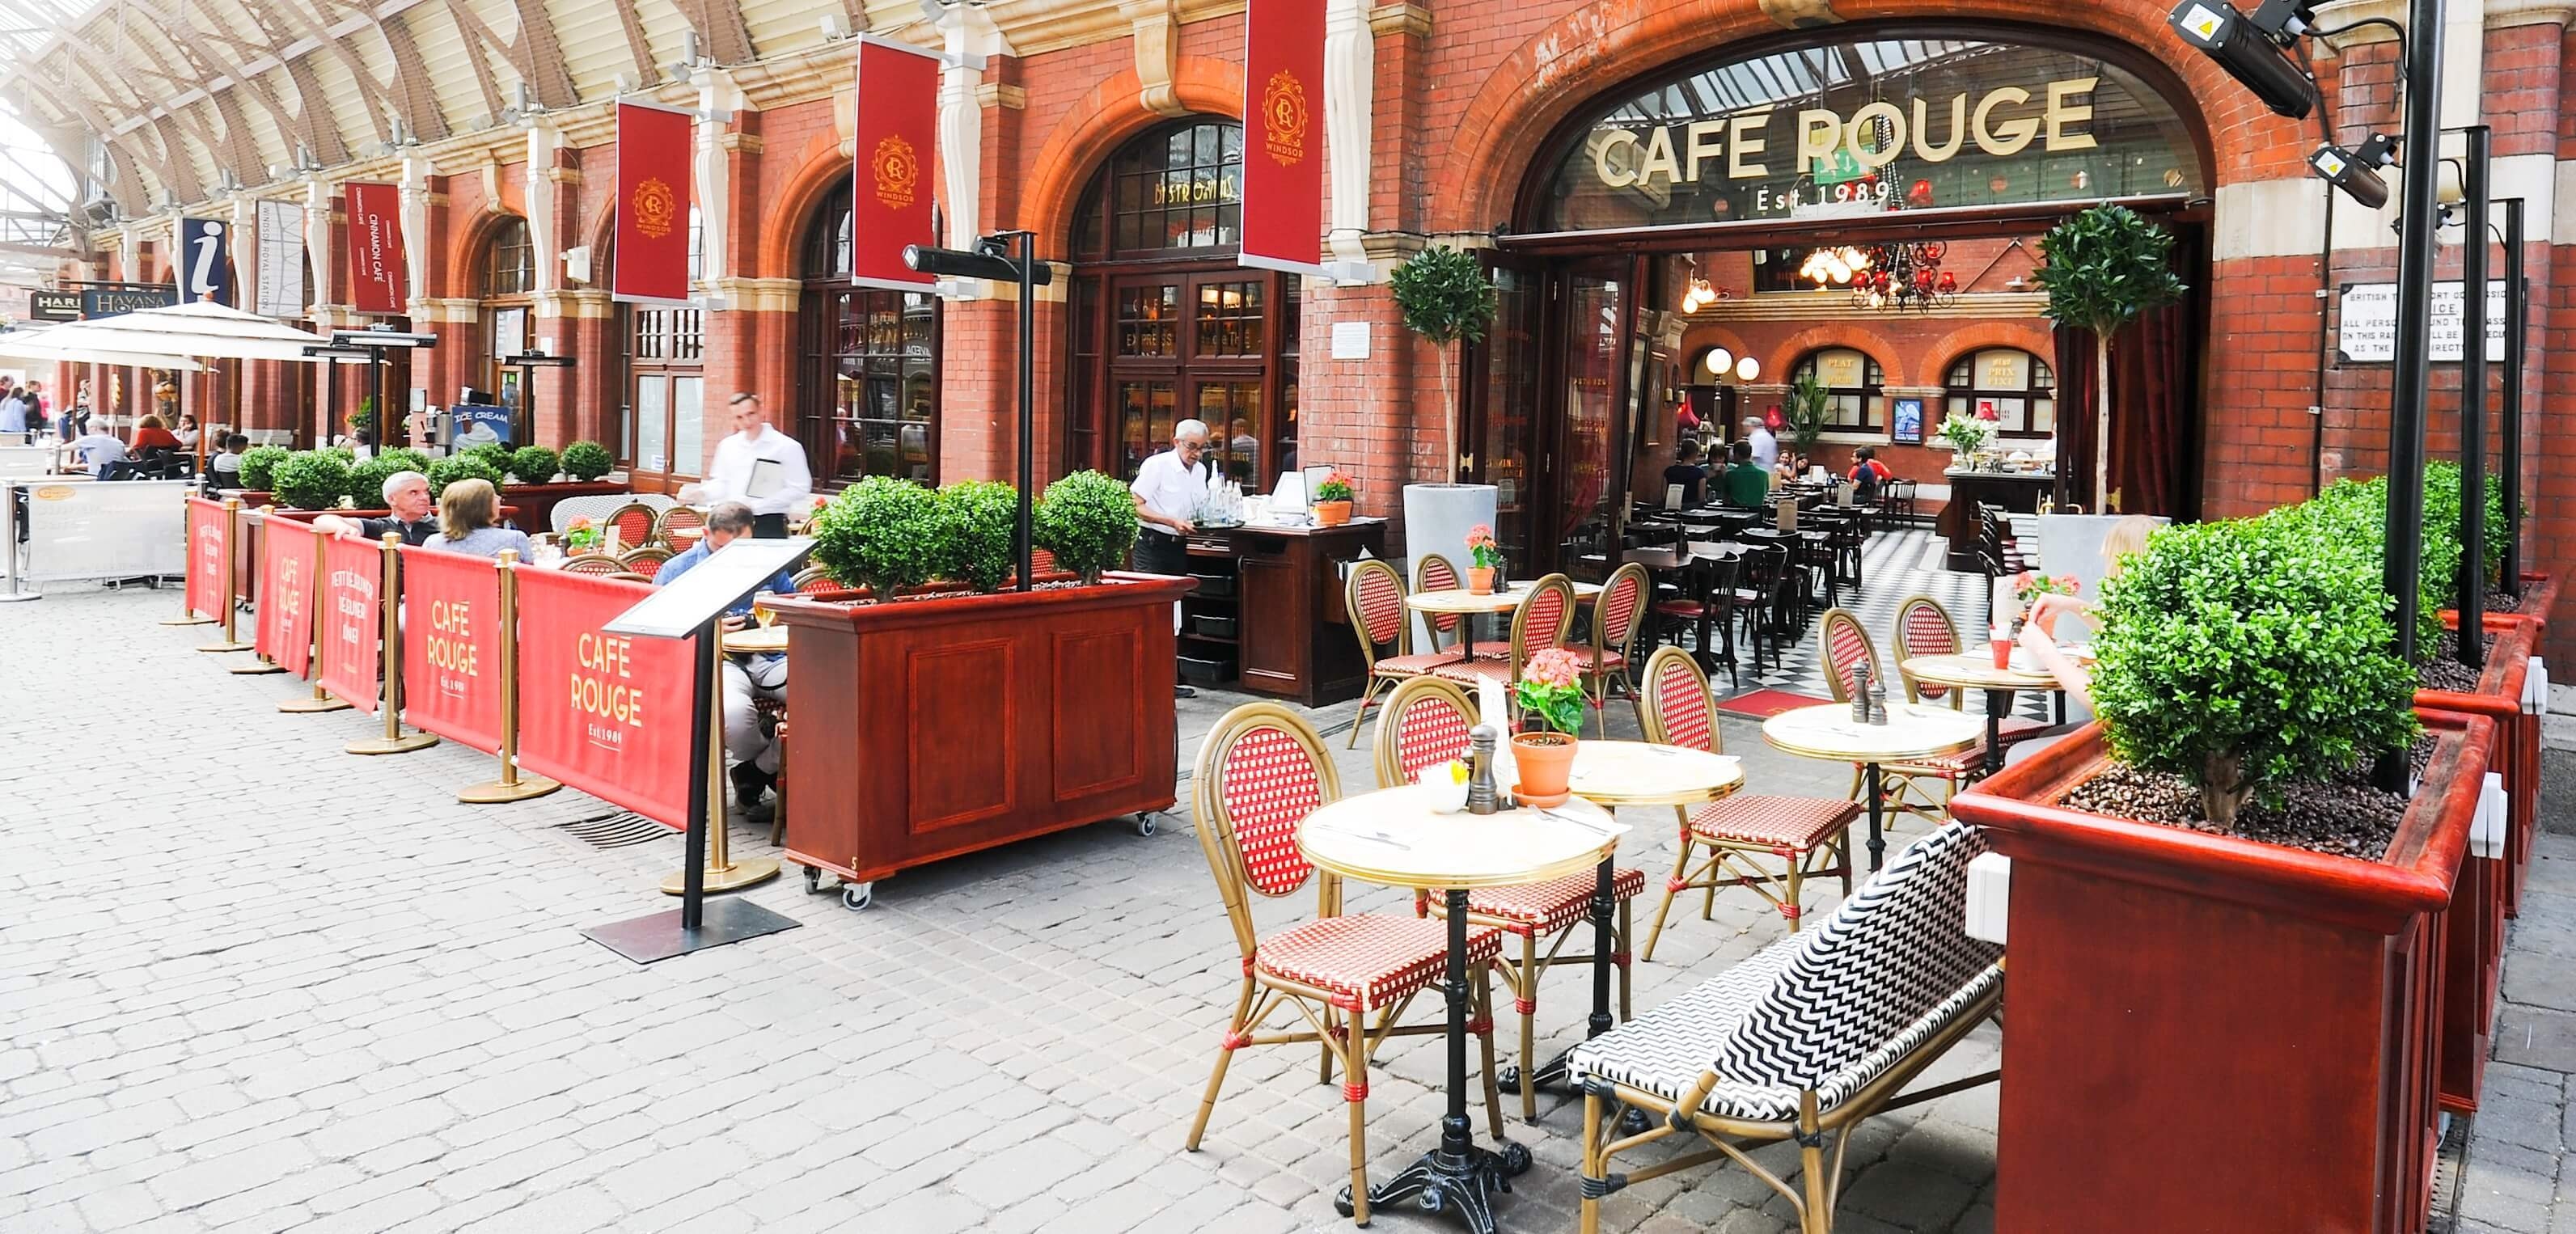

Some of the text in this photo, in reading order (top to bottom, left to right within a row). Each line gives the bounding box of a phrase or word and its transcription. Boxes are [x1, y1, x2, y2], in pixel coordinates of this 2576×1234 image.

[1595, 77, 2099, 188] CAFÉ ROUGE
[1266, 142, 1305, 158] WINDSOR
[876, 191, 914, 202] WINDSOR
[1757, 181, 1890, 211] Est. 1989
[262, 246, 270, 272] ROYAL
[369, 213, 386, 282] CINNAMON CAFÉ
[38, 297, 81, 308] HAR
[96, 294, 166, 312] HAVANA
[2350, 293, 2388, 301] BRITISH
[2358, 331, 2375, 340] THIS
[2447, 331, 2458, 339] BE
[454, 411, 509, 424] ICE CREAM
[431, 599, 471, 637] CAFÉ
[426, 634, 479, 677] ROUGE
[578, 632, 632, 679] CAFÉ
[570, 672, 643, 728] ROUGE
